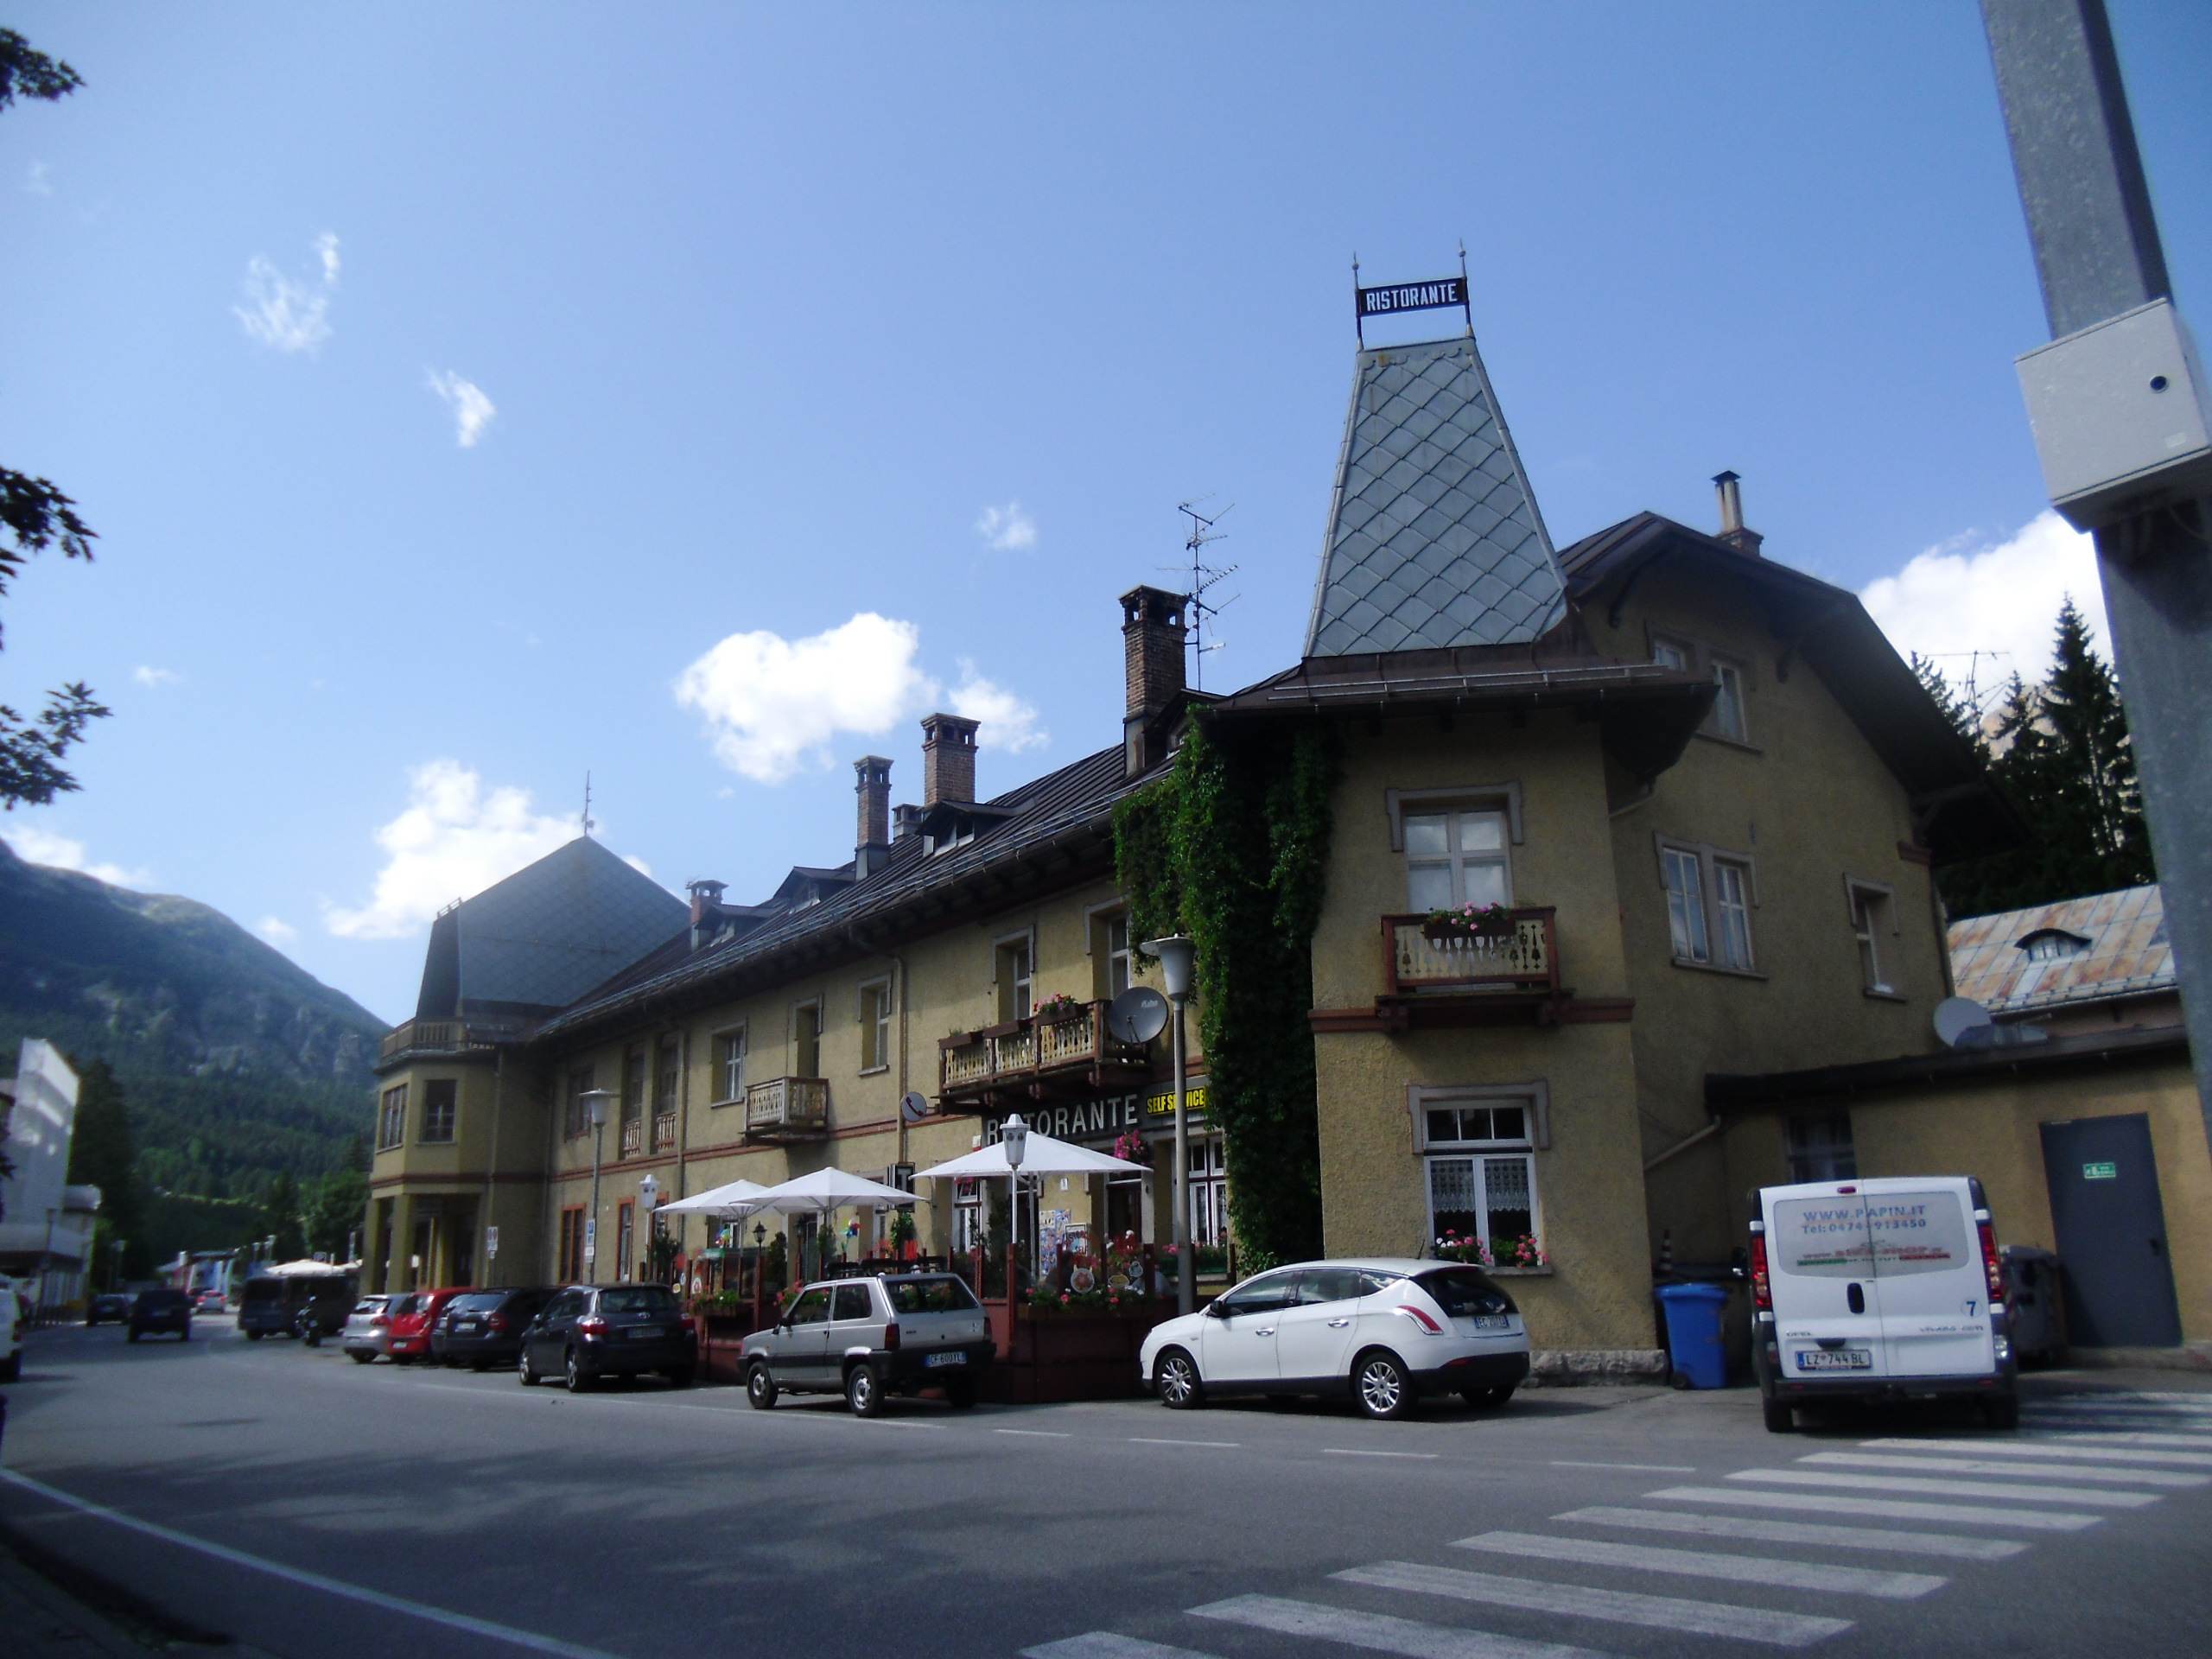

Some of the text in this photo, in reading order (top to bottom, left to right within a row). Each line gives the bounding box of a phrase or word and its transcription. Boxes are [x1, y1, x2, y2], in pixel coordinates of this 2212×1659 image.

[1366, 283, 1458, 311] RISTORANTE
[1147, 1096, 1166, 1114] SELF
[987, 1094, 1138, 1146] RTORANTE
[1802, 1205, 1926, 1221] WWW.PAPIN.IT
[1802, 1224, 1827, 1234] Tel:
[1966, 1300, 1977, 1317] 7
[1806, 1353, 1866, 1365] LZ 744 BL
